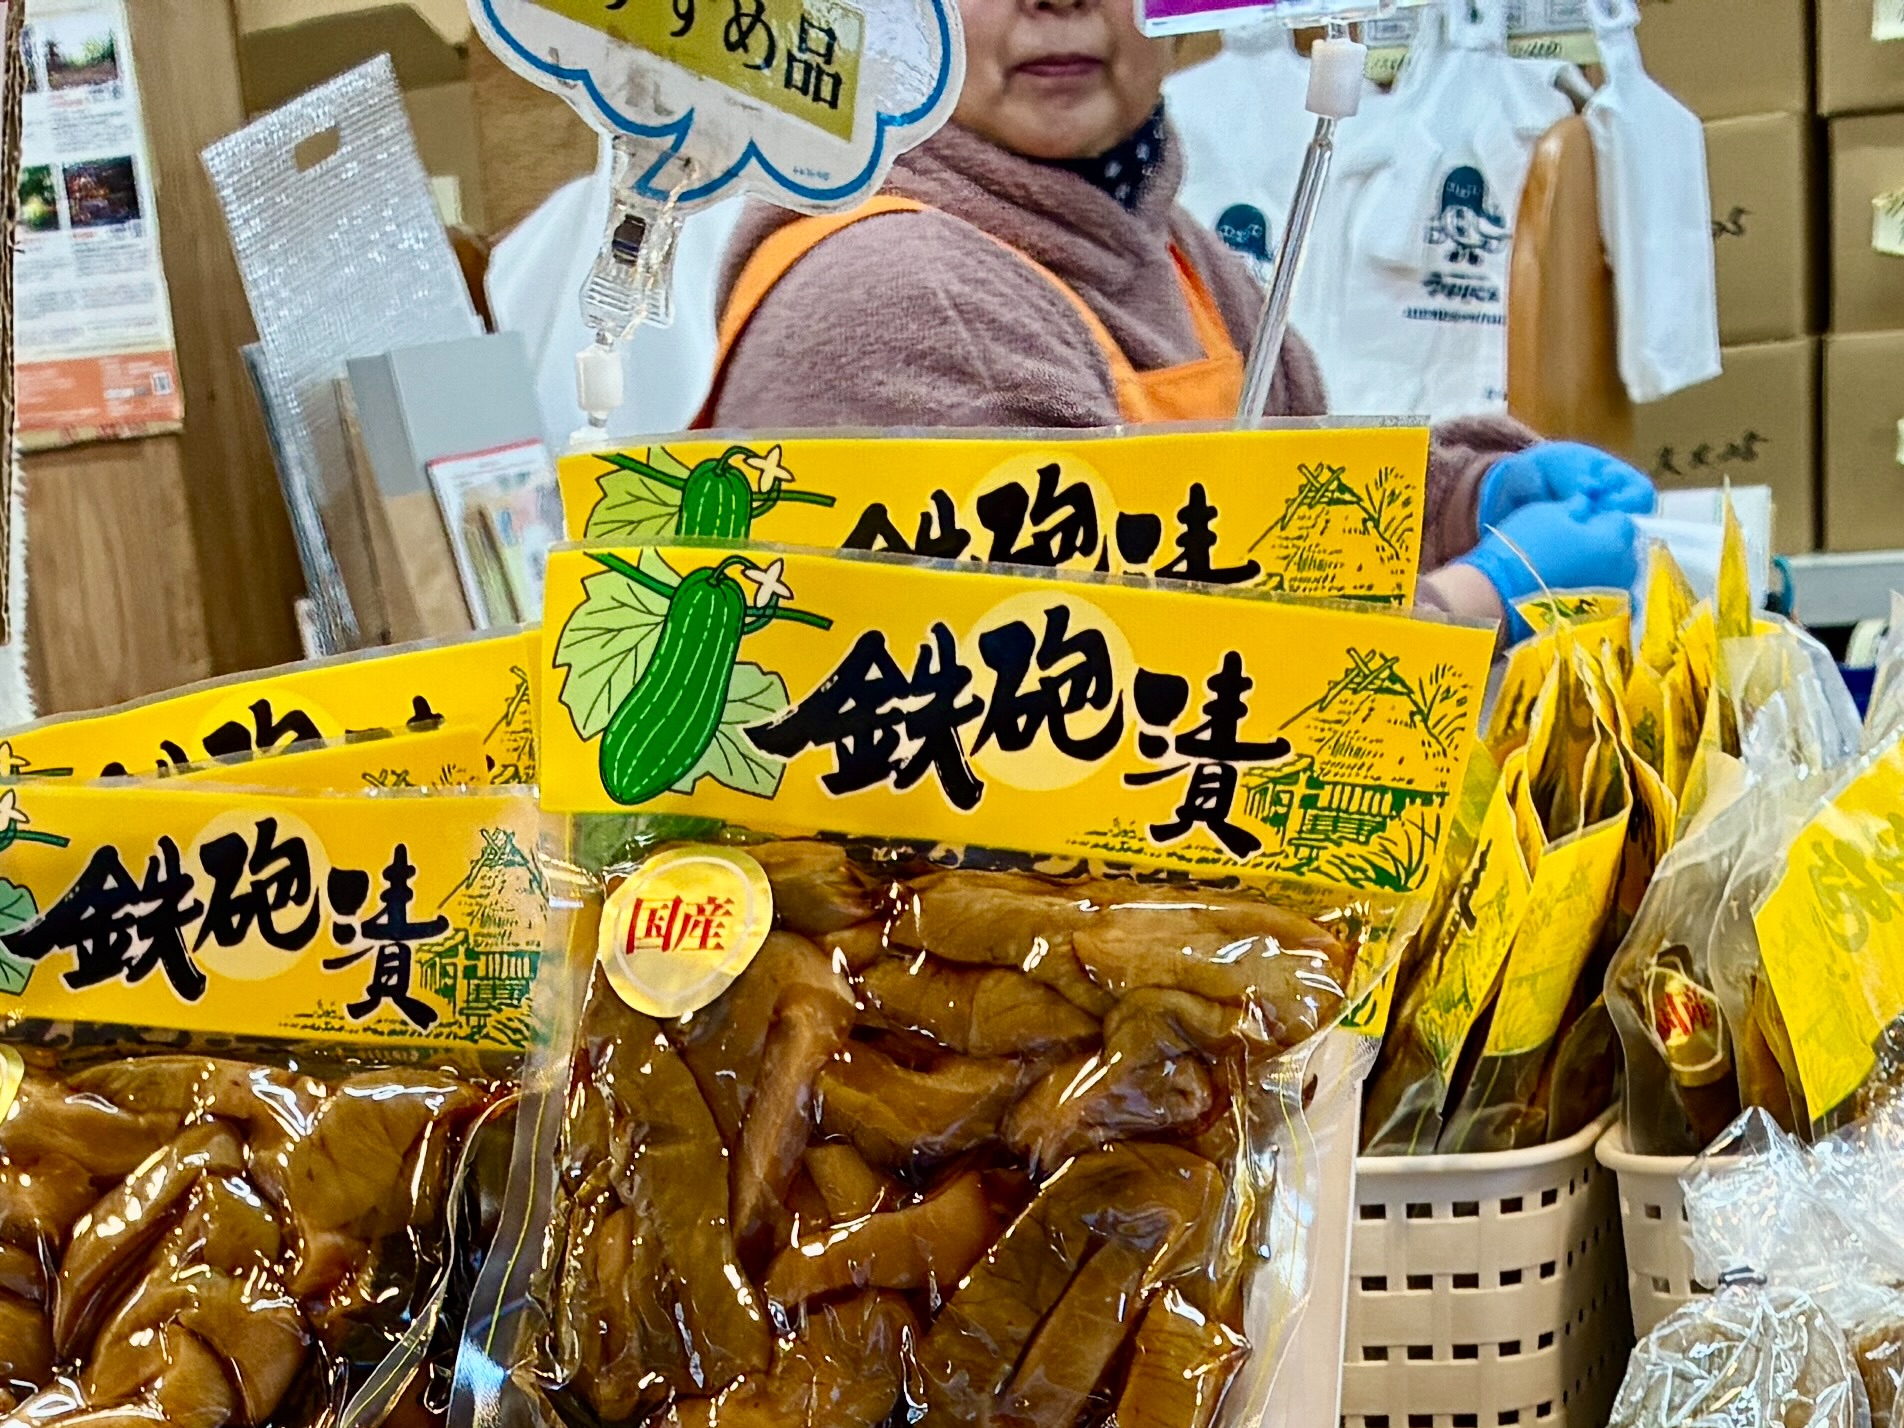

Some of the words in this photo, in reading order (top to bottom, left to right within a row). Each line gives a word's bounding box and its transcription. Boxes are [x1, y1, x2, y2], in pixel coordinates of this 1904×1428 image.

[746, 603, 1291, 862] 鉄砲漬
[1, 814, 450, 1029] 鉄砲漬
[625, 893, 736, 957] 国産
